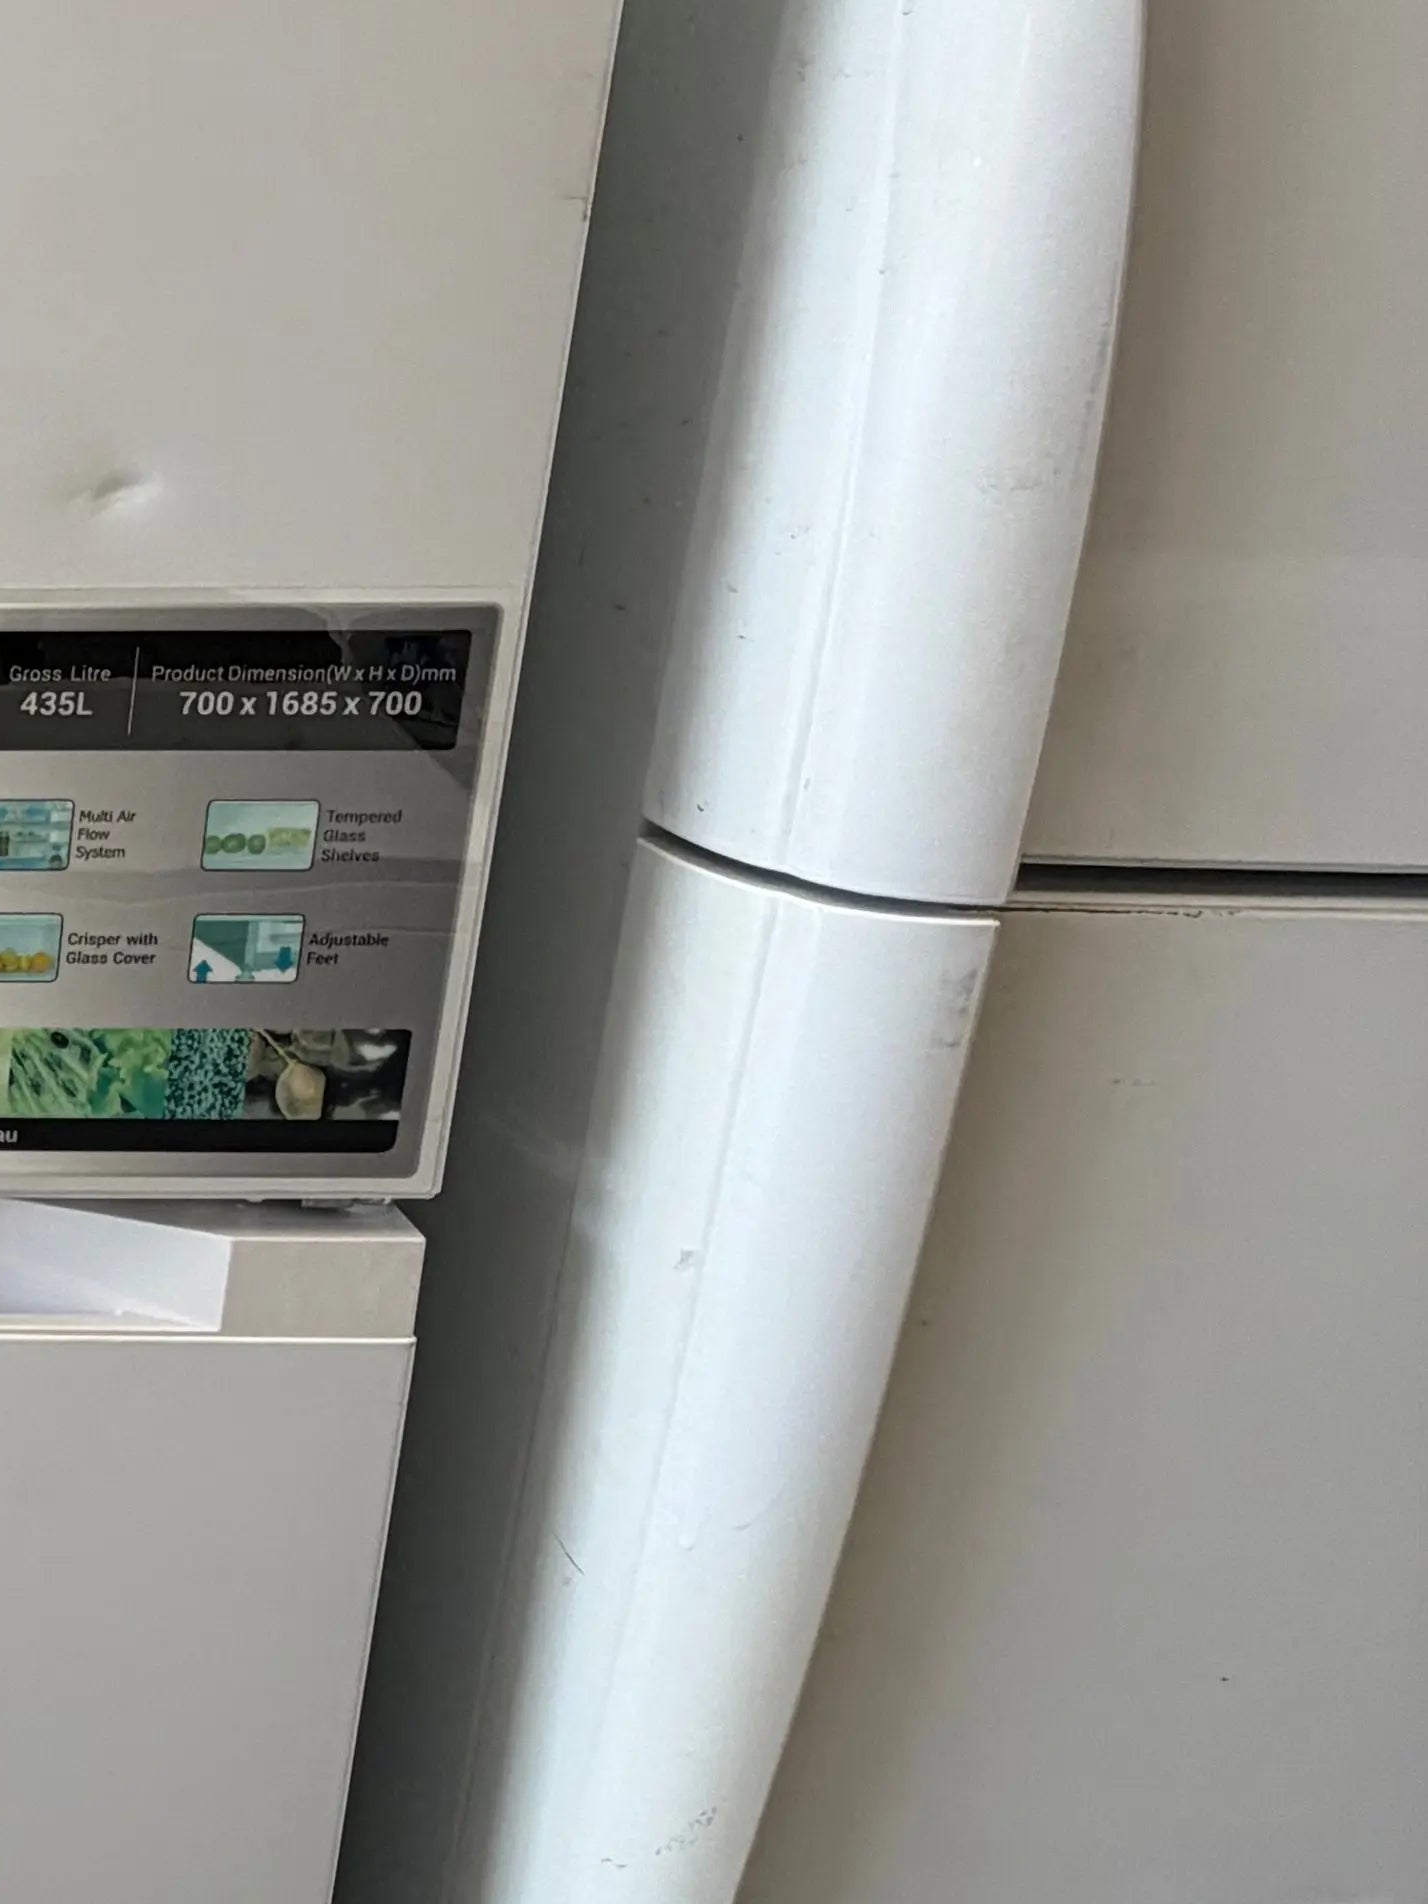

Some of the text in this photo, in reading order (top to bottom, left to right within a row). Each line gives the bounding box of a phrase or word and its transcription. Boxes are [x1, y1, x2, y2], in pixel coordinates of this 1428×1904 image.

[8, 664, 112, 682] Gross Litre
[151, 663, 225, 682] Product
[353, 667, 365, 682] x
[368, 664, 384, 682] H
[386, 667, 397, 682] x
[19, 690, 94, 717] 435L
[179, 690, 423, 716] 700 x 1685 x 700
[78, 809, 136, 824] Multi Air
[326, 809, 403, 827] Tempered
[77, 827, 110, 841] Flow
[323, 829, 366, 843] Glass
[75, 845, 126, 861] System
[320, 848, 380, 863] Shelves
[67, 932, 159, 949] Crisper with
[308, 932, 390, 949] Adjustable
[66, 951, 156, 966] Glass Cover
[306, 951, 339, 965] Feet
